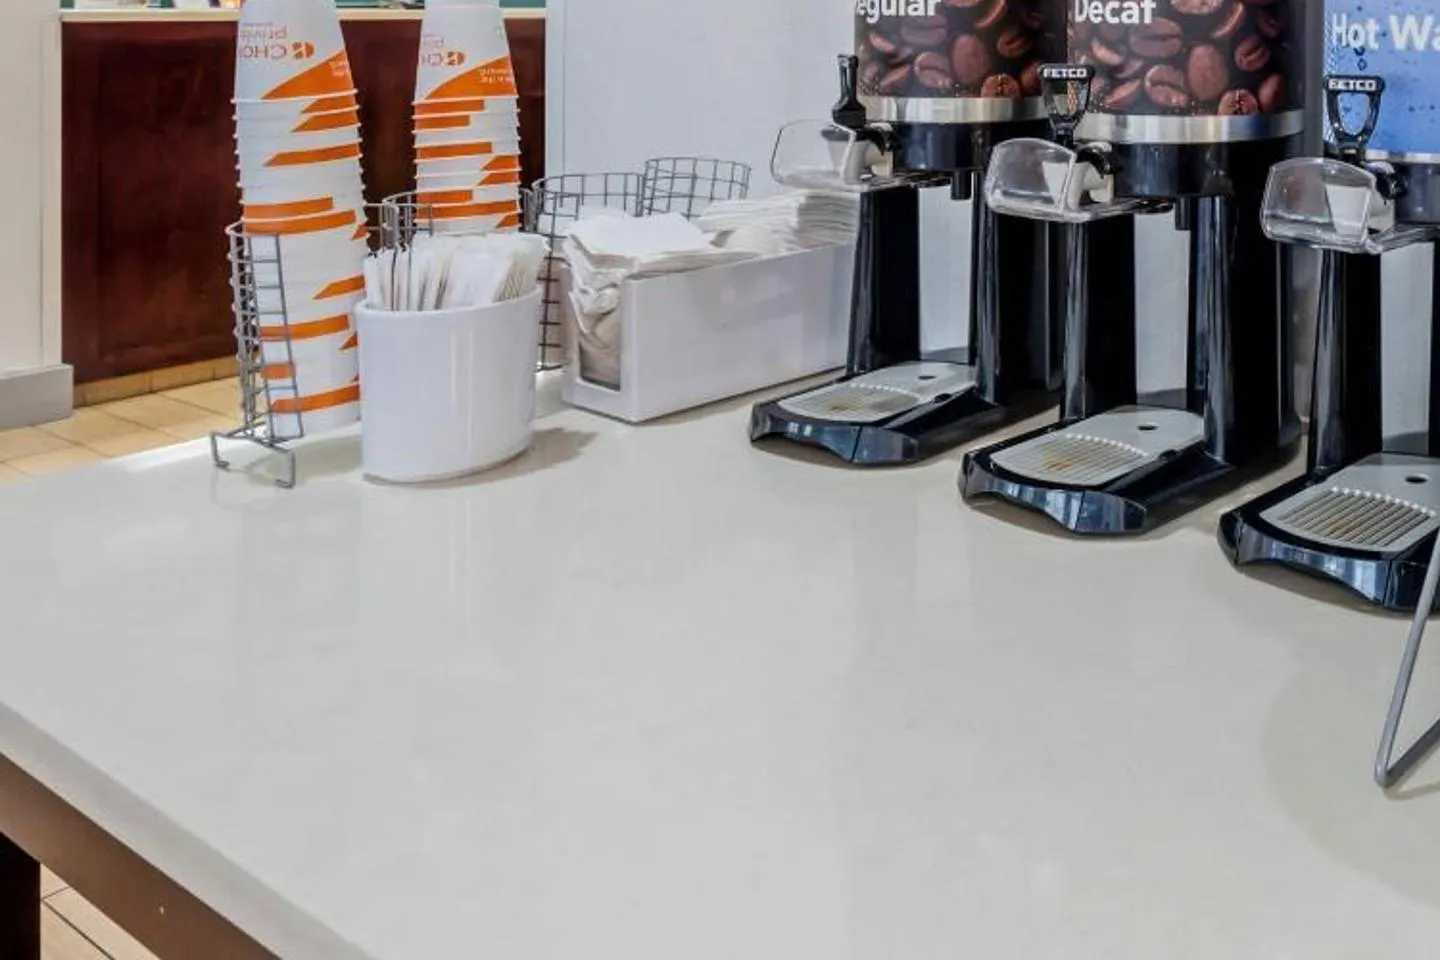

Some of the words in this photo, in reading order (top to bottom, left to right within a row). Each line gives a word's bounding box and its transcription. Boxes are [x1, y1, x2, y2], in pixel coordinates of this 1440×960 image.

[1332, 13, 1380, 50] Hot
[1043, 67, 1087, 78] FETCO
[1328, 79, 1376, 90] FETCO
